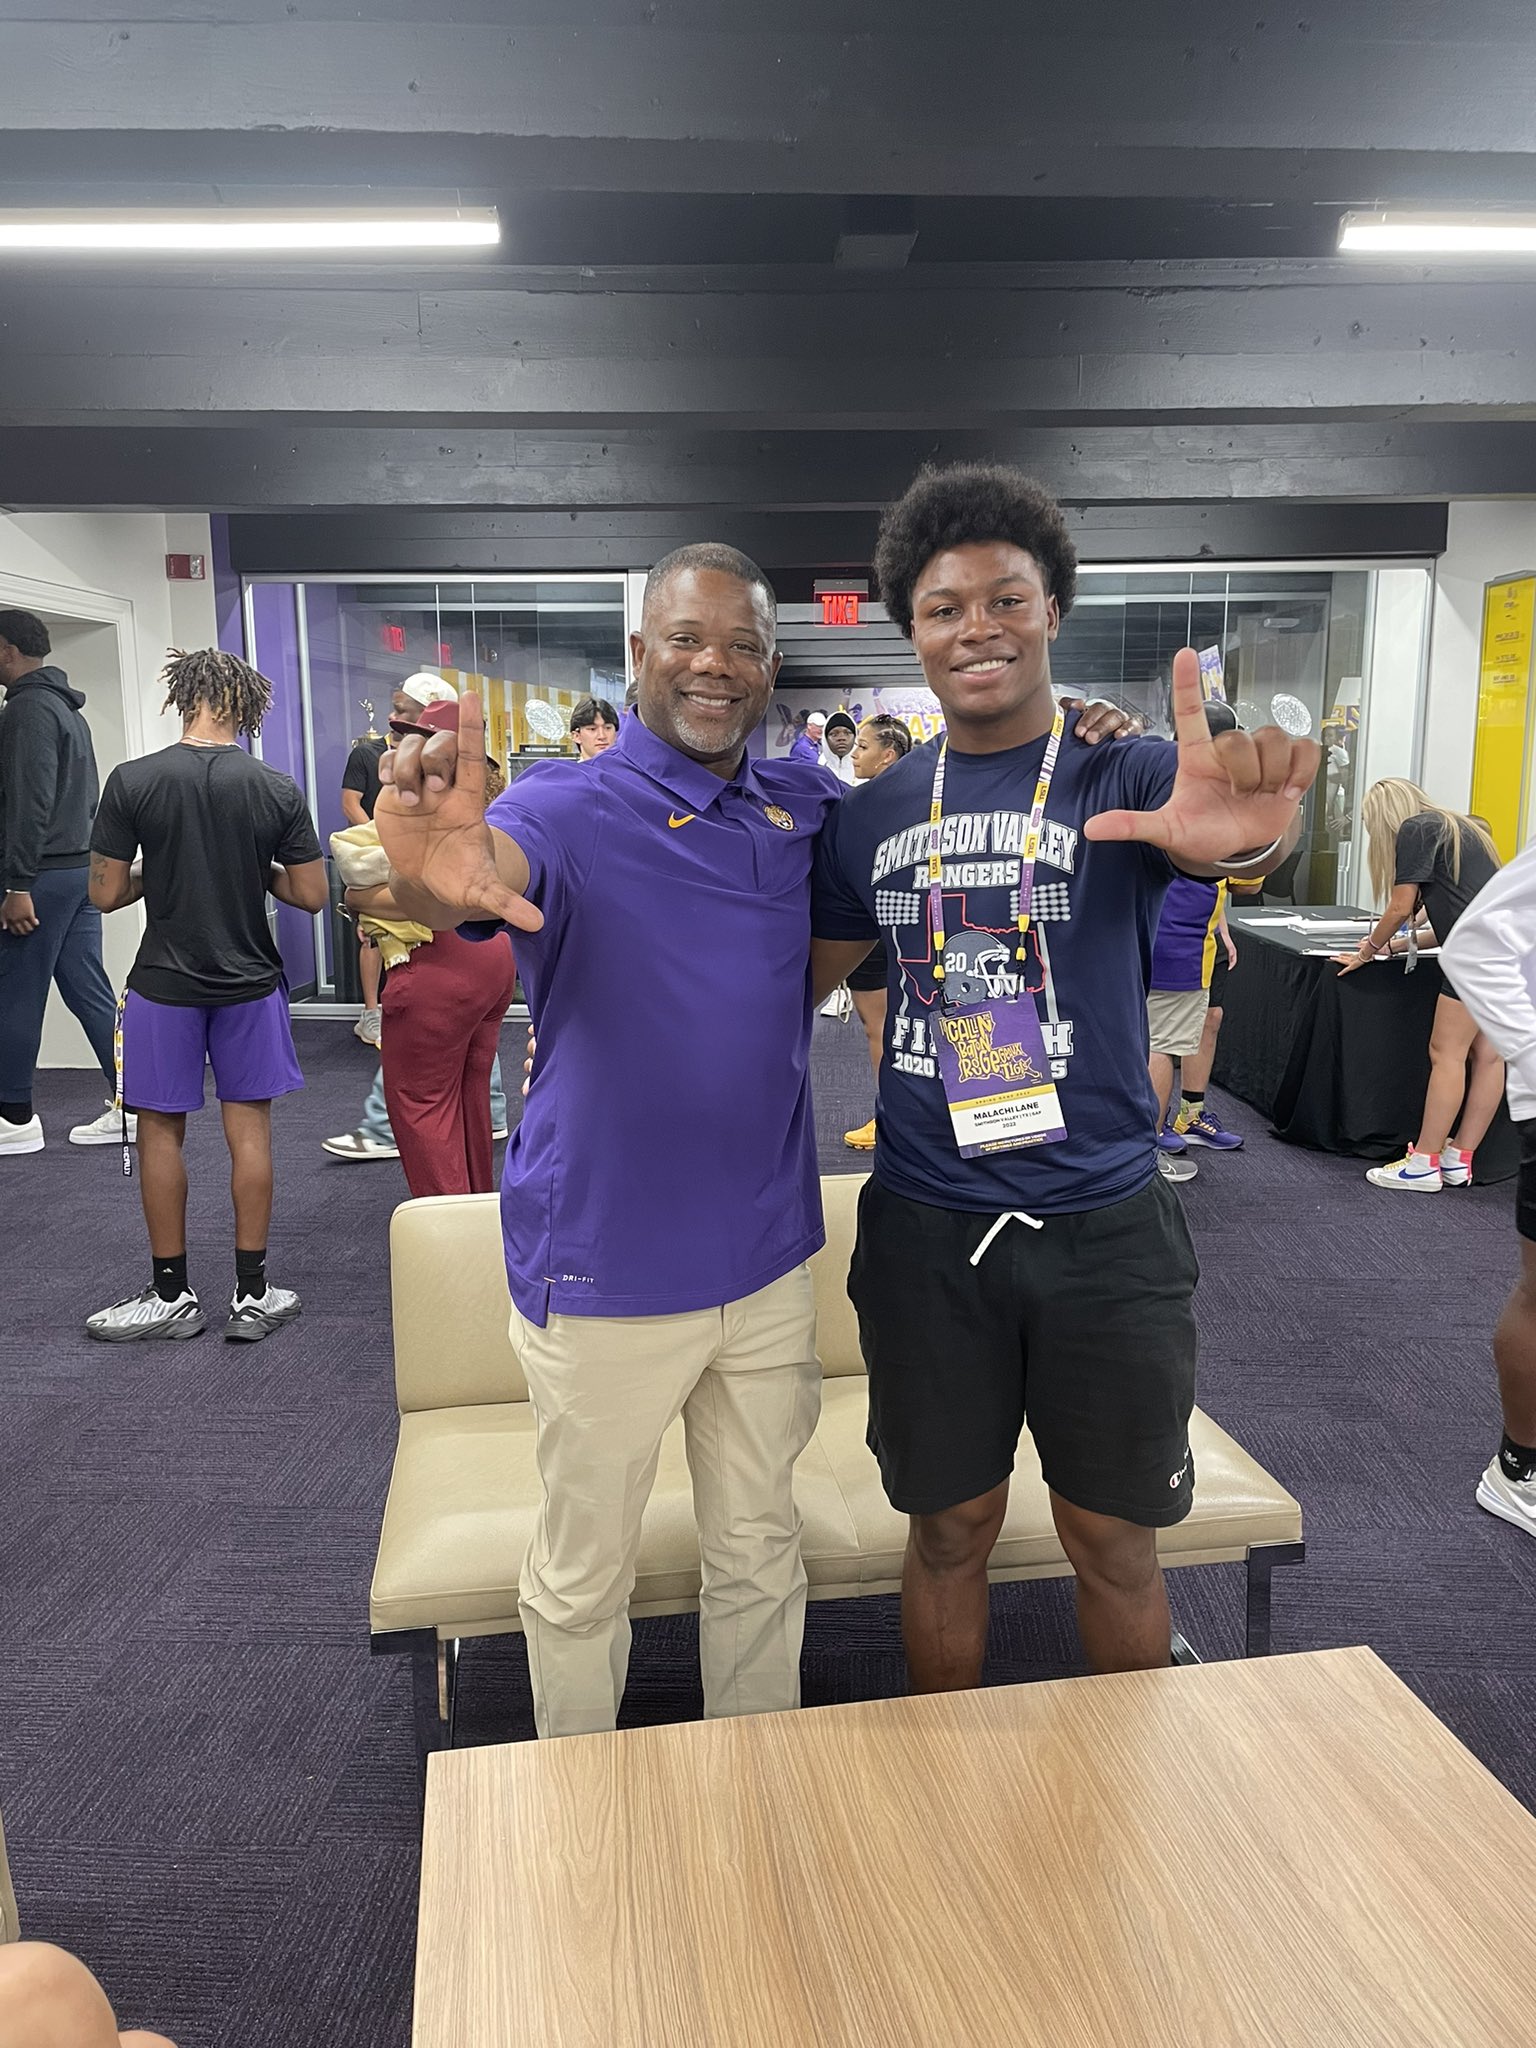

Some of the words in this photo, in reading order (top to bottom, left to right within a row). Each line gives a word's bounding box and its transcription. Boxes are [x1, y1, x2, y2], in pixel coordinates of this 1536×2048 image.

[871, 812, 990, 885] SMITSON
[912, 859, 1020, 889] RNGERS
[945, 952, 967, 972] 20
[891, 1051, 935, 1079] 2020
[973, 1106, 1015, 1120] MALACHI
[1015, 1101, 1040, 1112] LANE
[562, 1274, 594, 1284] DRI-FIT
